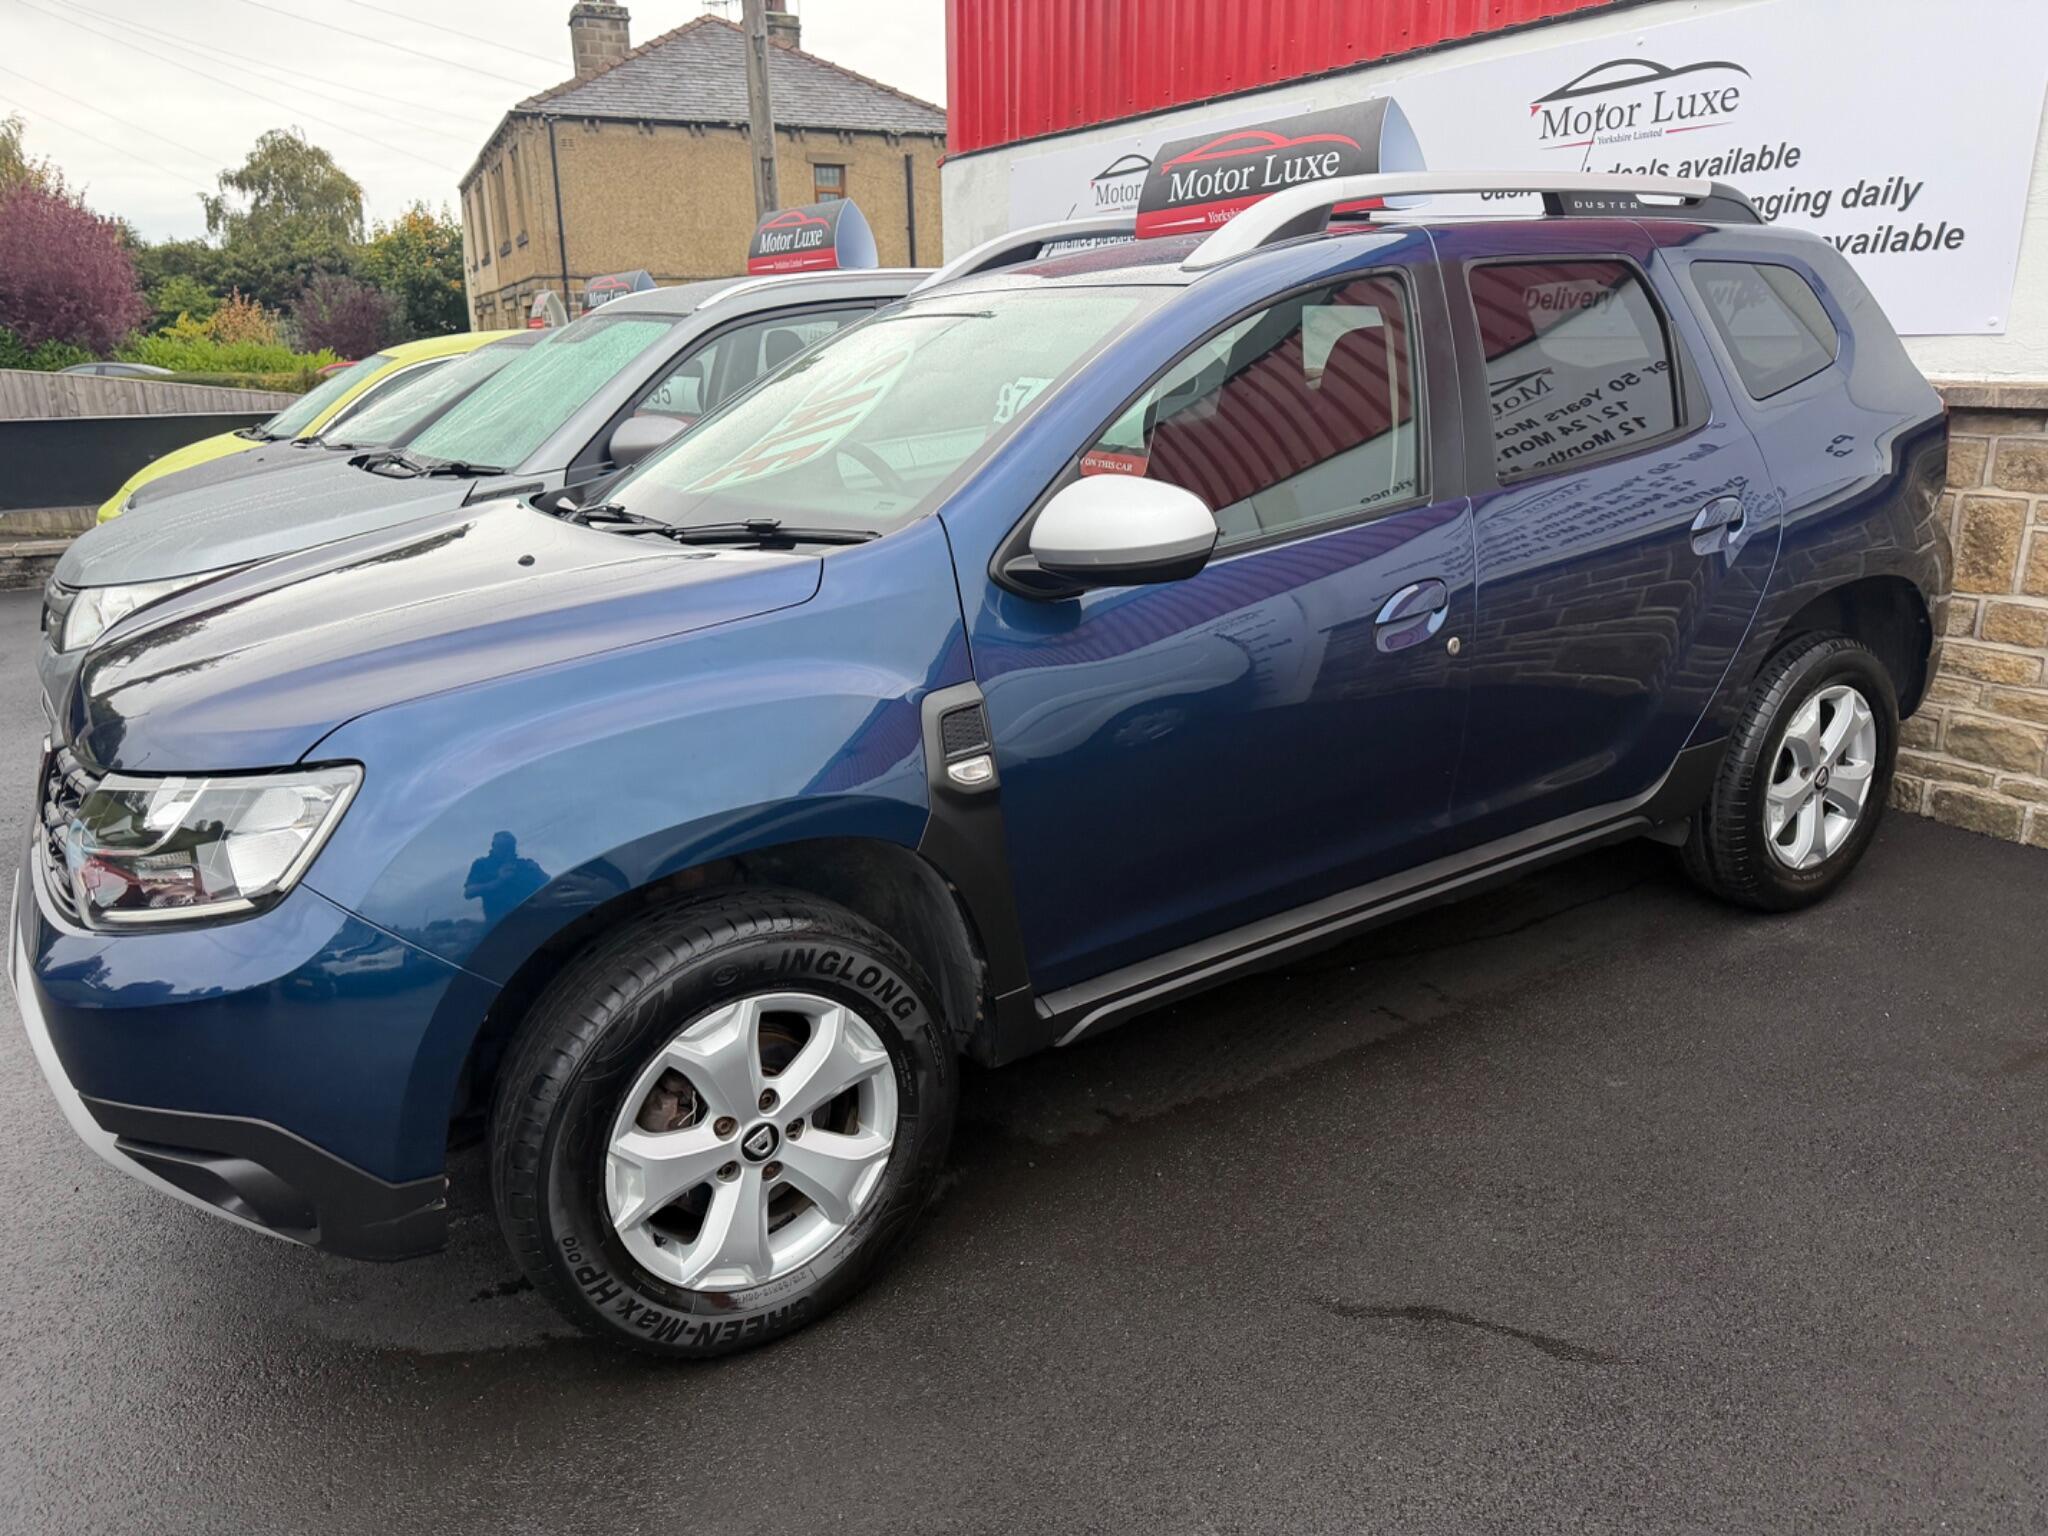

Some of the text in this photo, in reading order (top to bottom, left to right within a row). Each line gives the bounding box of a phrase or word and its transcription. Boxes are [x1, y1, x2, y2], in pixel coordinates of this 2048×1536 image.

[1539, 86, 1740, 140] Motor Luxe
[1677, 142, 1801, 178] available
[1168, 150, 1341, 203] Motor Luxe
[1095, 182, 1142, 206] Motor
[1574, 200, 1638, 209] DUSTER
[1840, 175, 1924, 212] daily
[759, 228, 823, 254] Motor Luxe
[1116, 462, 1133, 472] CAR
